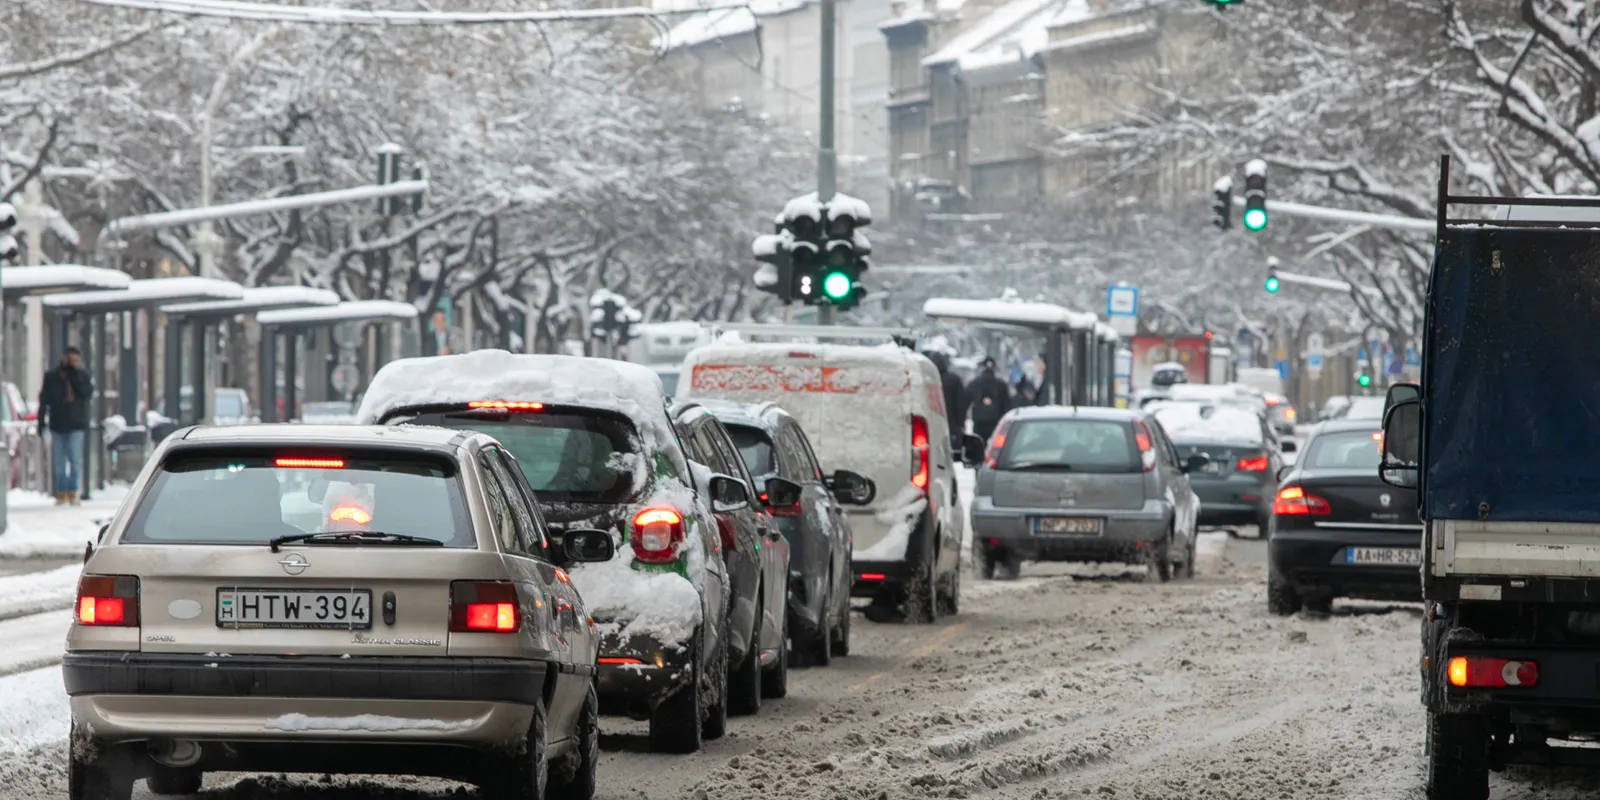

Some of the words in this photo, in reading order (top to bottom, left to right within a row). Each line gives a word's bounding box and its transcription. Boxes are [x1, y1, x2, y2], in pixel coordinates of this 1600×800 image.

[222, 607, 233, 618] H
[242, 595, 365, 620] HTW-394
[351, 637, 391, 645] ASTRA
